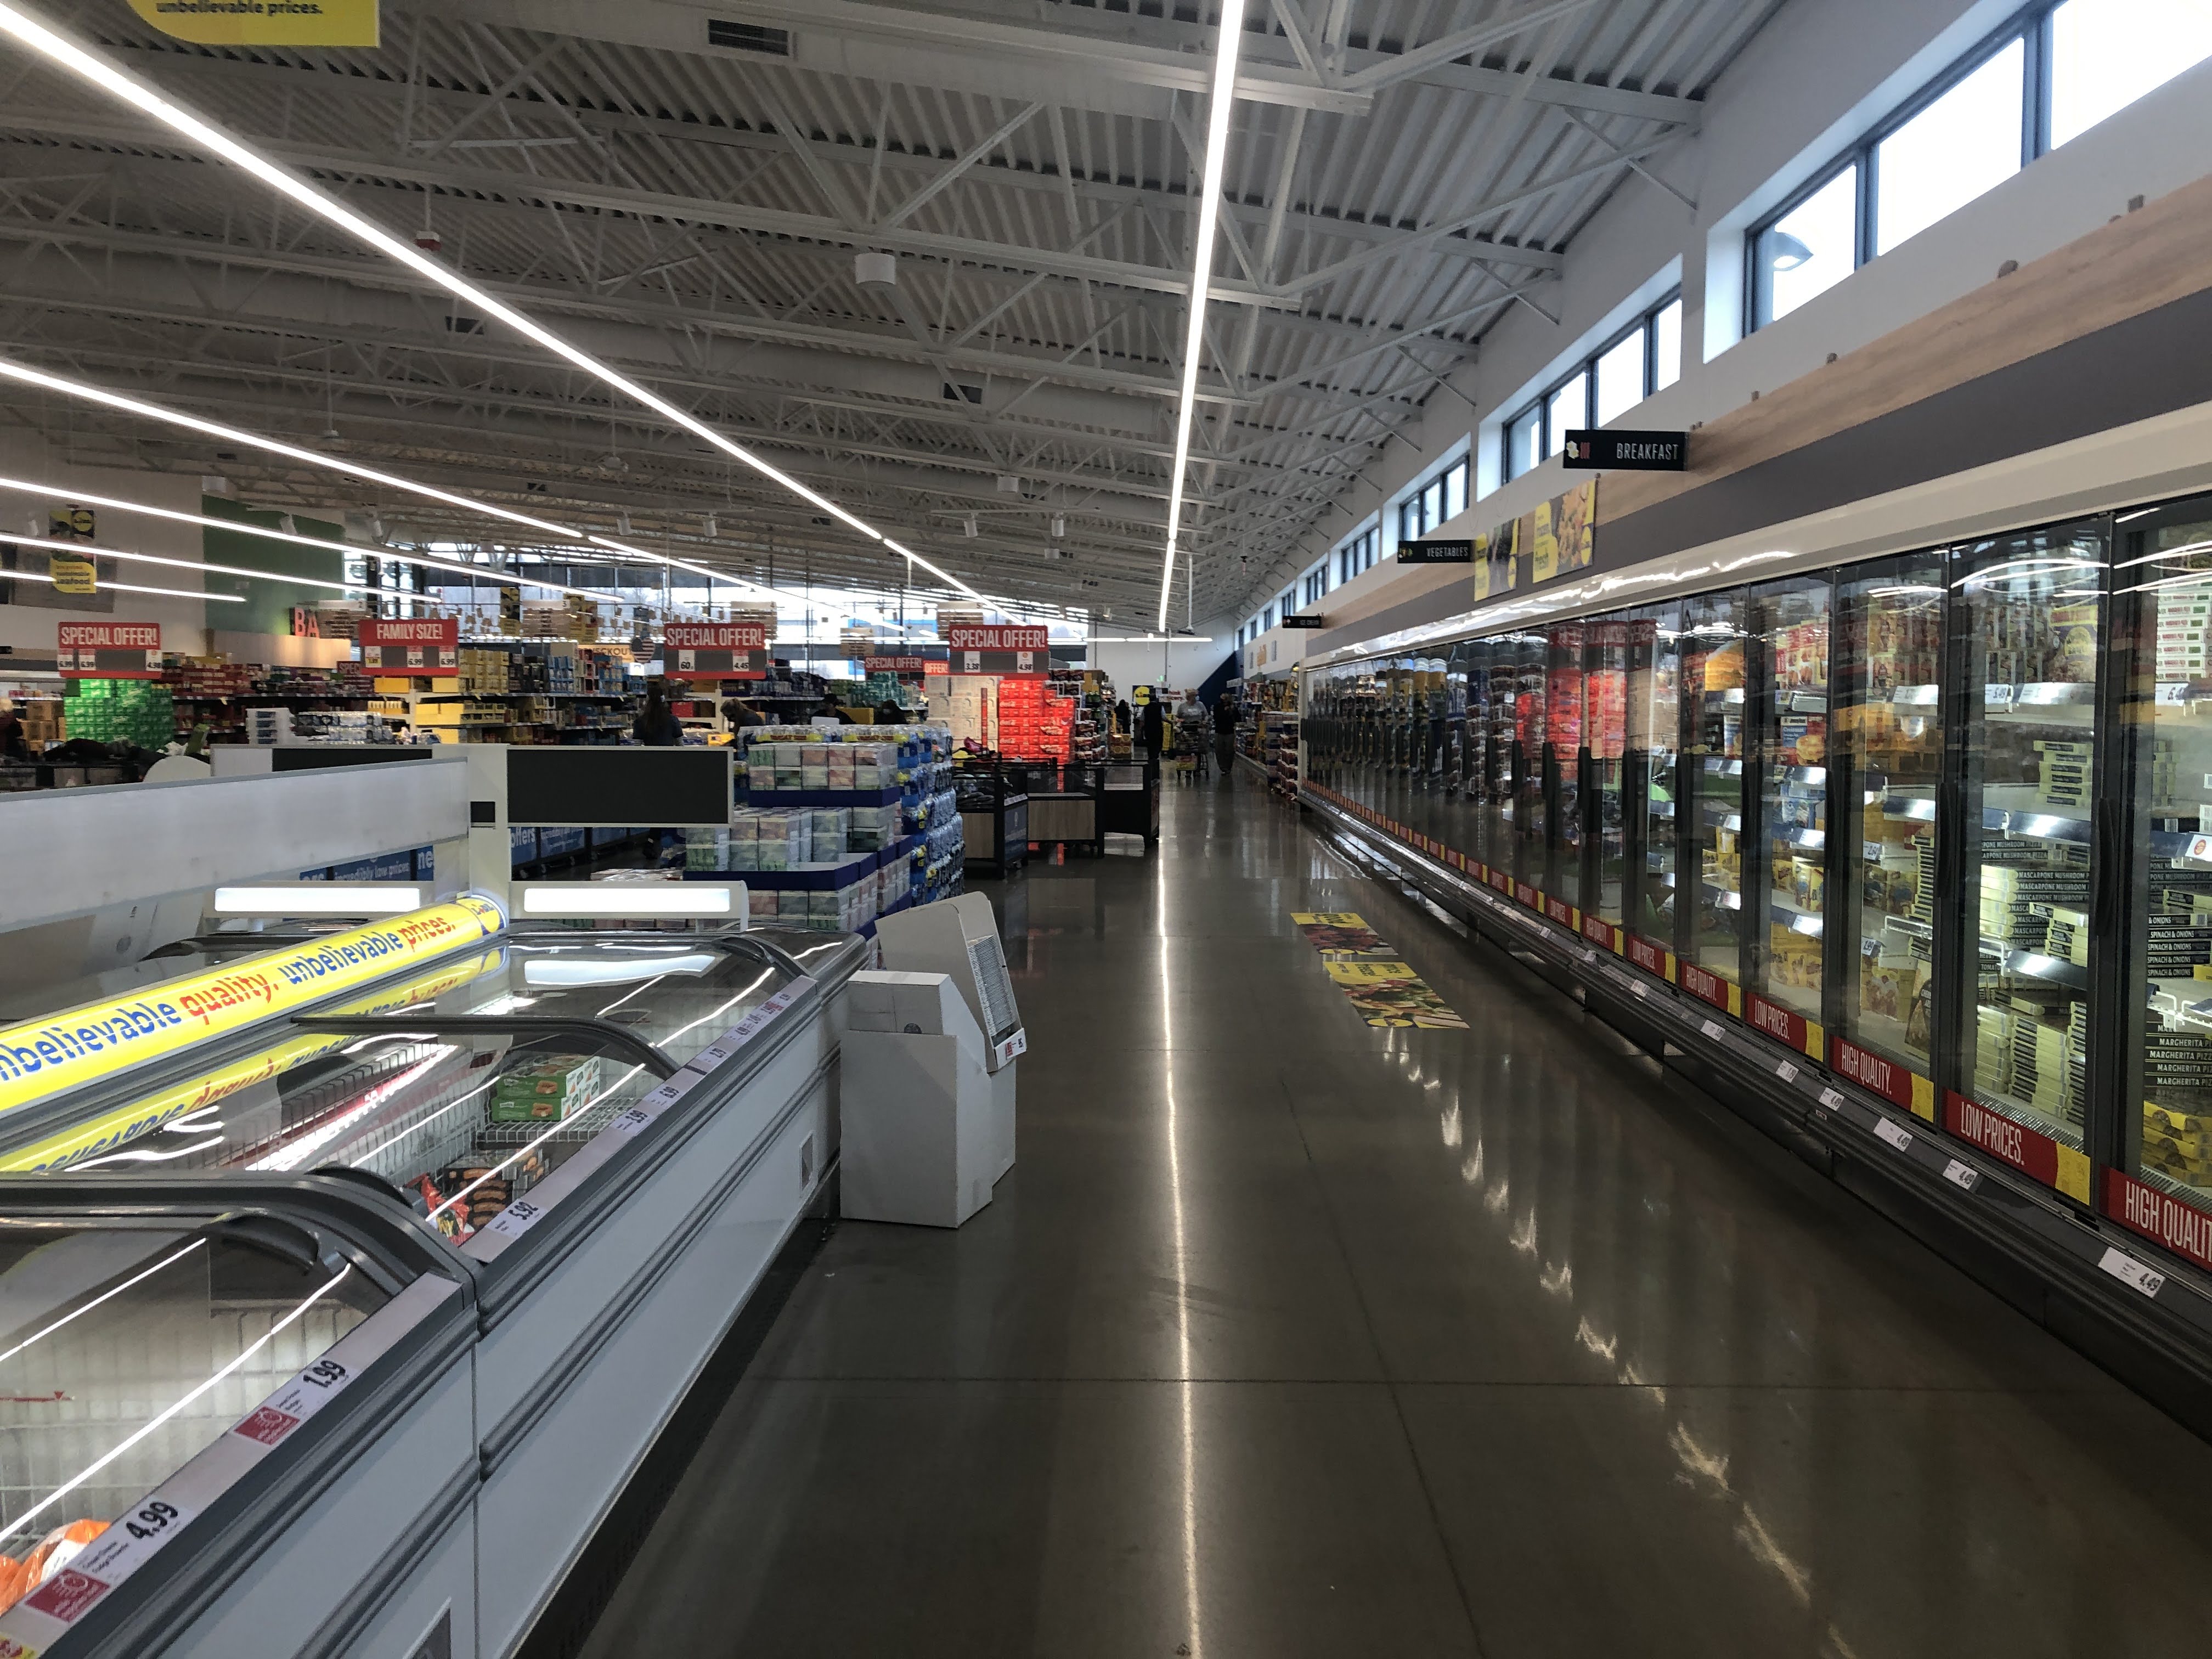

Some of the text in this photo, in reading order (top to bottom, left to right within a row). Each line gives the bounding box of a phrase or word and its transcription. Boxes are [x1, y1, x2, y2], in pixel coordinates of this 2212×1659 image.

[1617, 443, 1678, 460] BREAKFAST
[1426, 547, 1468, 557] VEGETABLES
[295, 607, 319, 638] BA
[376, 624, 443, 639] FAMILY SIZE!
[61, 627, 157, 645] SPECIAL OFFER!
[667, 628, 762, 646] SPECIAL OFFER!
[951, 629, 1045, 648] SPECIAL OFFER!
[866, 657, 922, 668] SPECIAL OFFER!
[375, 866, 388, 878] low
[388, 860, 409, 875] prices
[278, 931, 403, 984] unbelievable
[1686, 965, 1717, 1001] HIGH QUALITY.
[1755, 999, 1790, 1040] LOW PRICES.
[2159, 1038, 2203, 1047] MARGHERITA
[2149, 1050, 2194, 1059] MARGHERITA
[1842, 1043, 1892, 1095] HIGH QUALITY.
[2157, 1064, 2201, 1073] MARGHERITA
[2157, 1077, 2200, 1086] MARGHERITA
[1961, 1101, 2024, 1165] LOW PRICES.
[2125, 1181, 2159, 1235] HIGH
[303, 1360, 346, 1388] 1.99
[126, 1501, 178, 1540] 4.99
